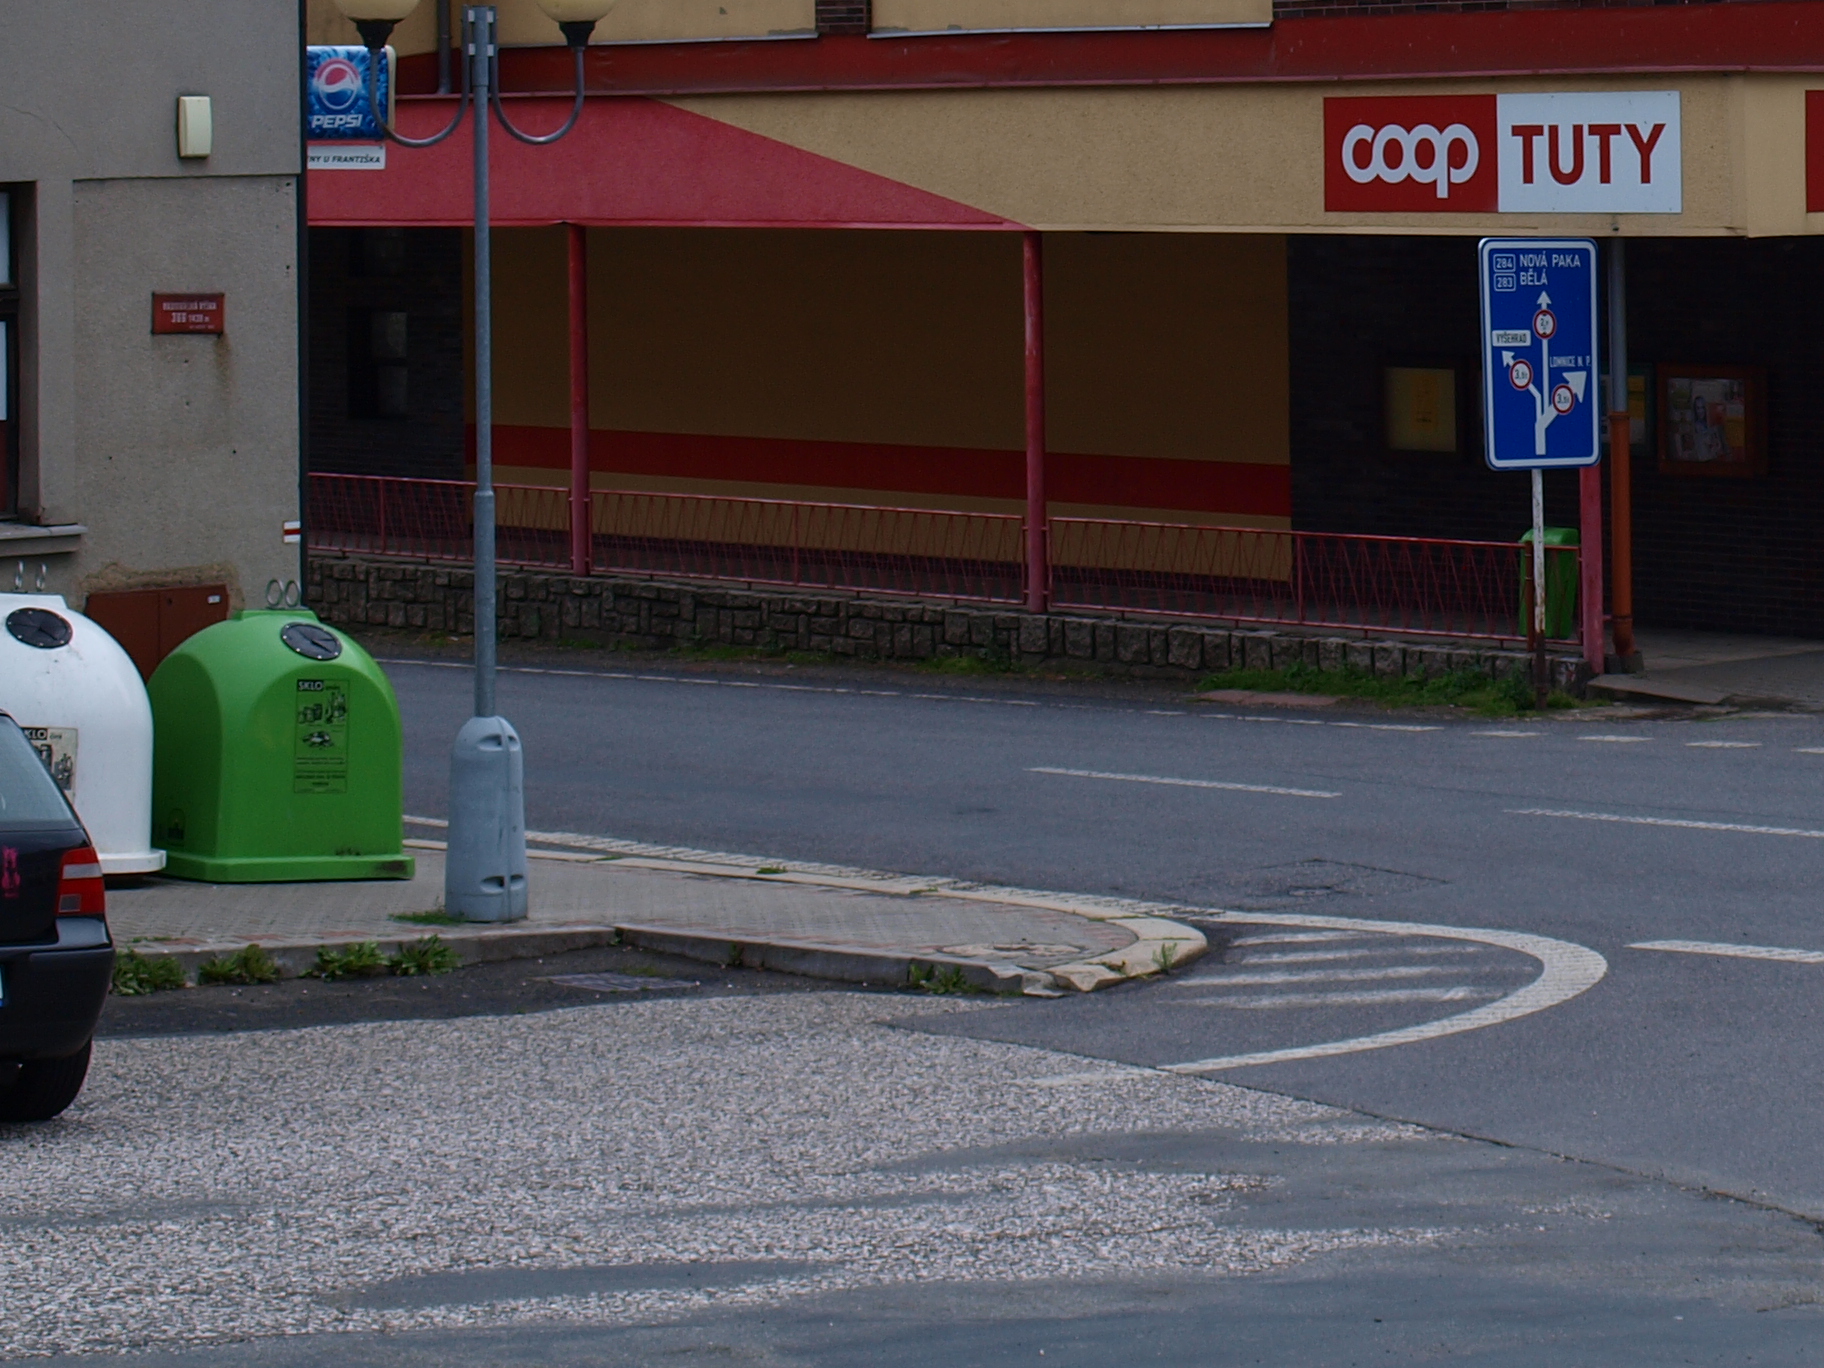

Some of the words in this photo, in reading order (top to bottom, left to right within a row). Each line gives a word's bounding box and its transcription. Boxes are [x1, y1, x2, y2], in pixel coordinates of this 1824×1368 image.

[311, 114, 363, 128] PEPSI
[307, 155, 321, 164] NY
[331, 153, 381, 164] FRANTIŠKA
[1341, 123, 1480, 199] coop
[1511, 122, 1666, 185] TUTY
[1496, 257, 1513, 269] 284
[1519, 250, 1548, 268] NOVÁ
[1552, 253, 1581, 268] PAKA
[1497, 277, 1513, 288] 283
[1519, 268, 1548, 285] BĚLÁ
[1496, 331, 1527, 343] VYŠEHRAD
[298, 681, 323, 691] SKLO
[24, 729, 47, 739] KLO
